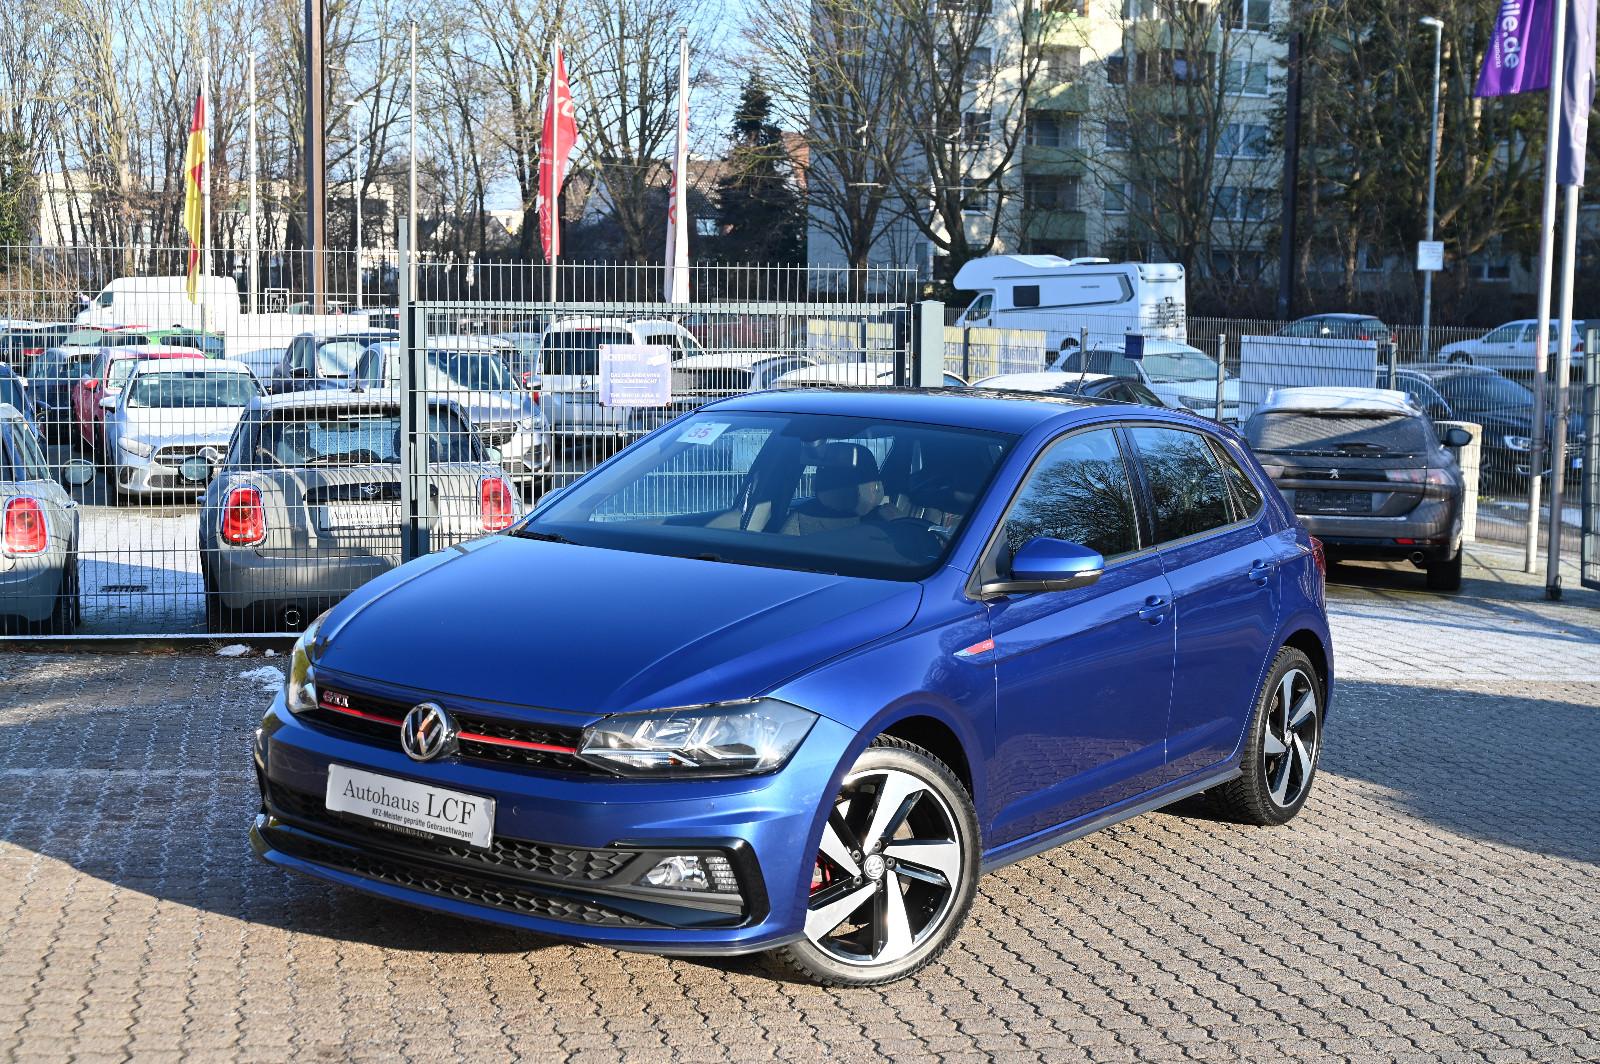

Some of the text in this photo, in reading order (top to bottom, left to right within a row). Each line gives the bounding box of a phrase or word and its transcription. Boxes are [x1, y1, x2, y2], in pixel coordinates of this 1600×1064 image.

[1502, 0, 1520, 69] ile.de
[688, 427, 712, 439] 35
[323, 691, 349, 708] GTI
[343, 778, 476, 825] Autohaus LCF
[371, 807, 403, 821] KFZ-Meister
[426, 820, 474, 839] Gebrauchtwagen!
